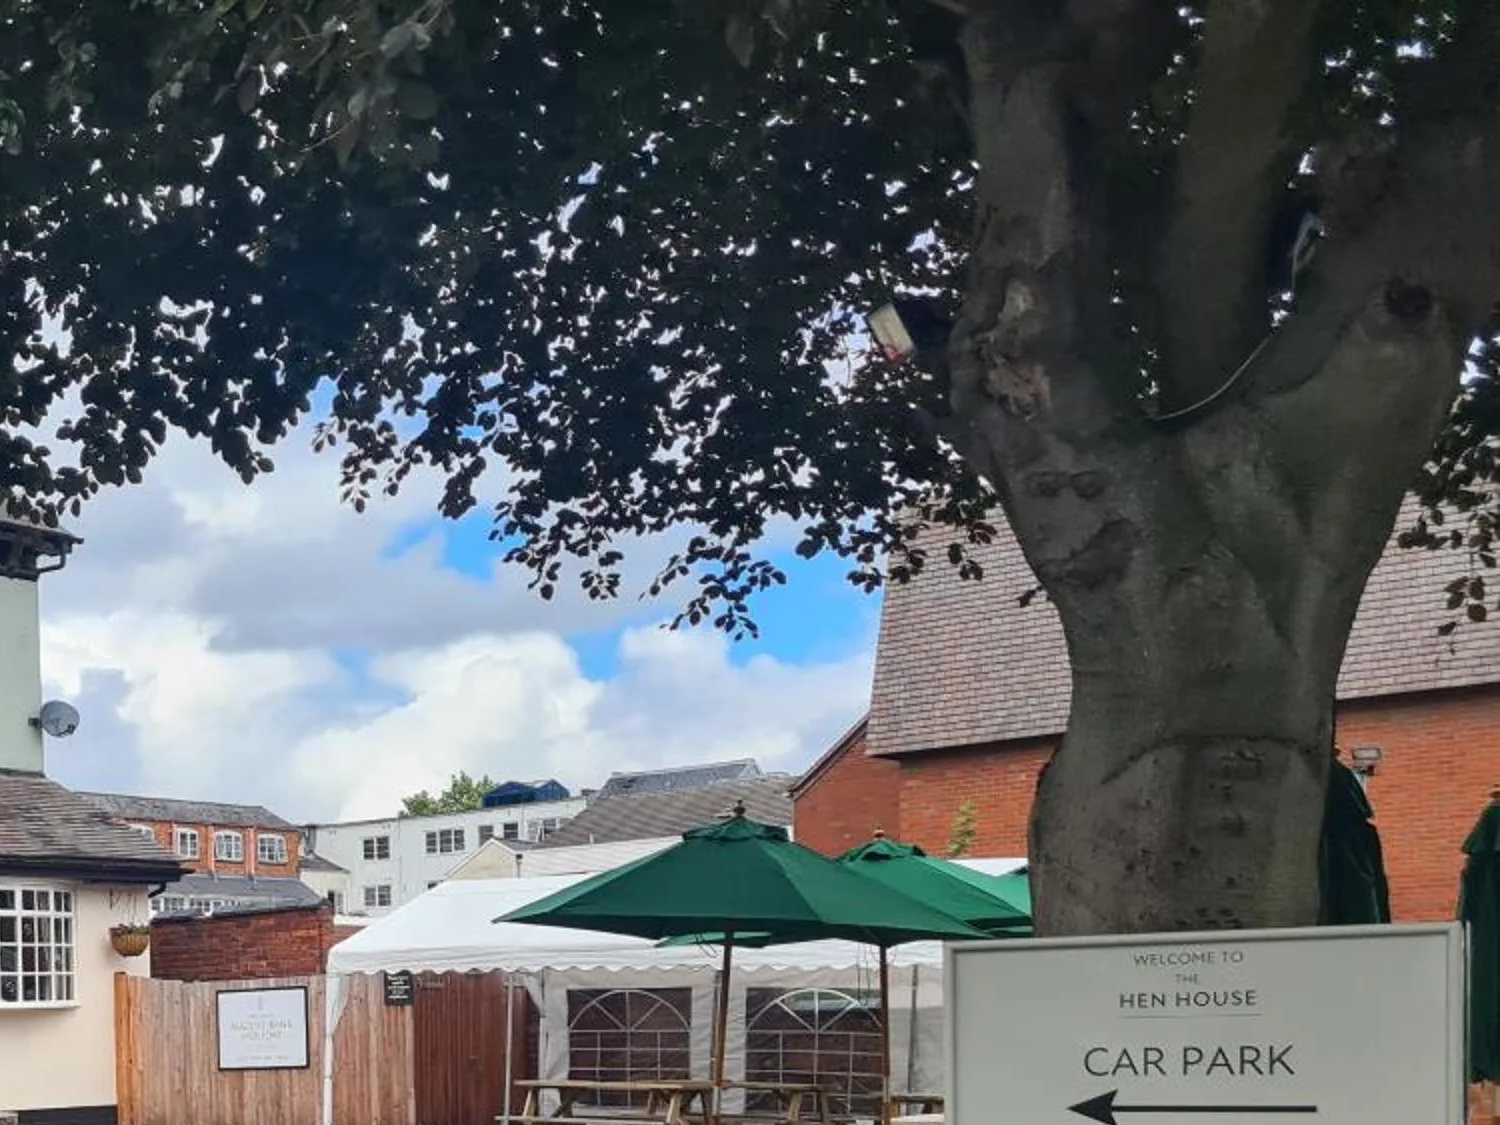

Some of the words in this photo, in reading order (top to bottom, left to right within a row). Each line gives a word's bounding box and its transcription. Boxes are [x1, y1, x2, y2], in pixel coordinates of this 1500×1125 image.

[1133, 951, 1215, 967] WELCOME
[1222, 950, 1244, 963] TO
[1175, 973, 1199, 985] THE
[1119, 993, 1166, 1009] HEN
[1175, 989, 1257, 1008] HOUSE
[1083, 1046, 1167, 1077] CAR
[1182, 1044, 1296, 1076] PARK
